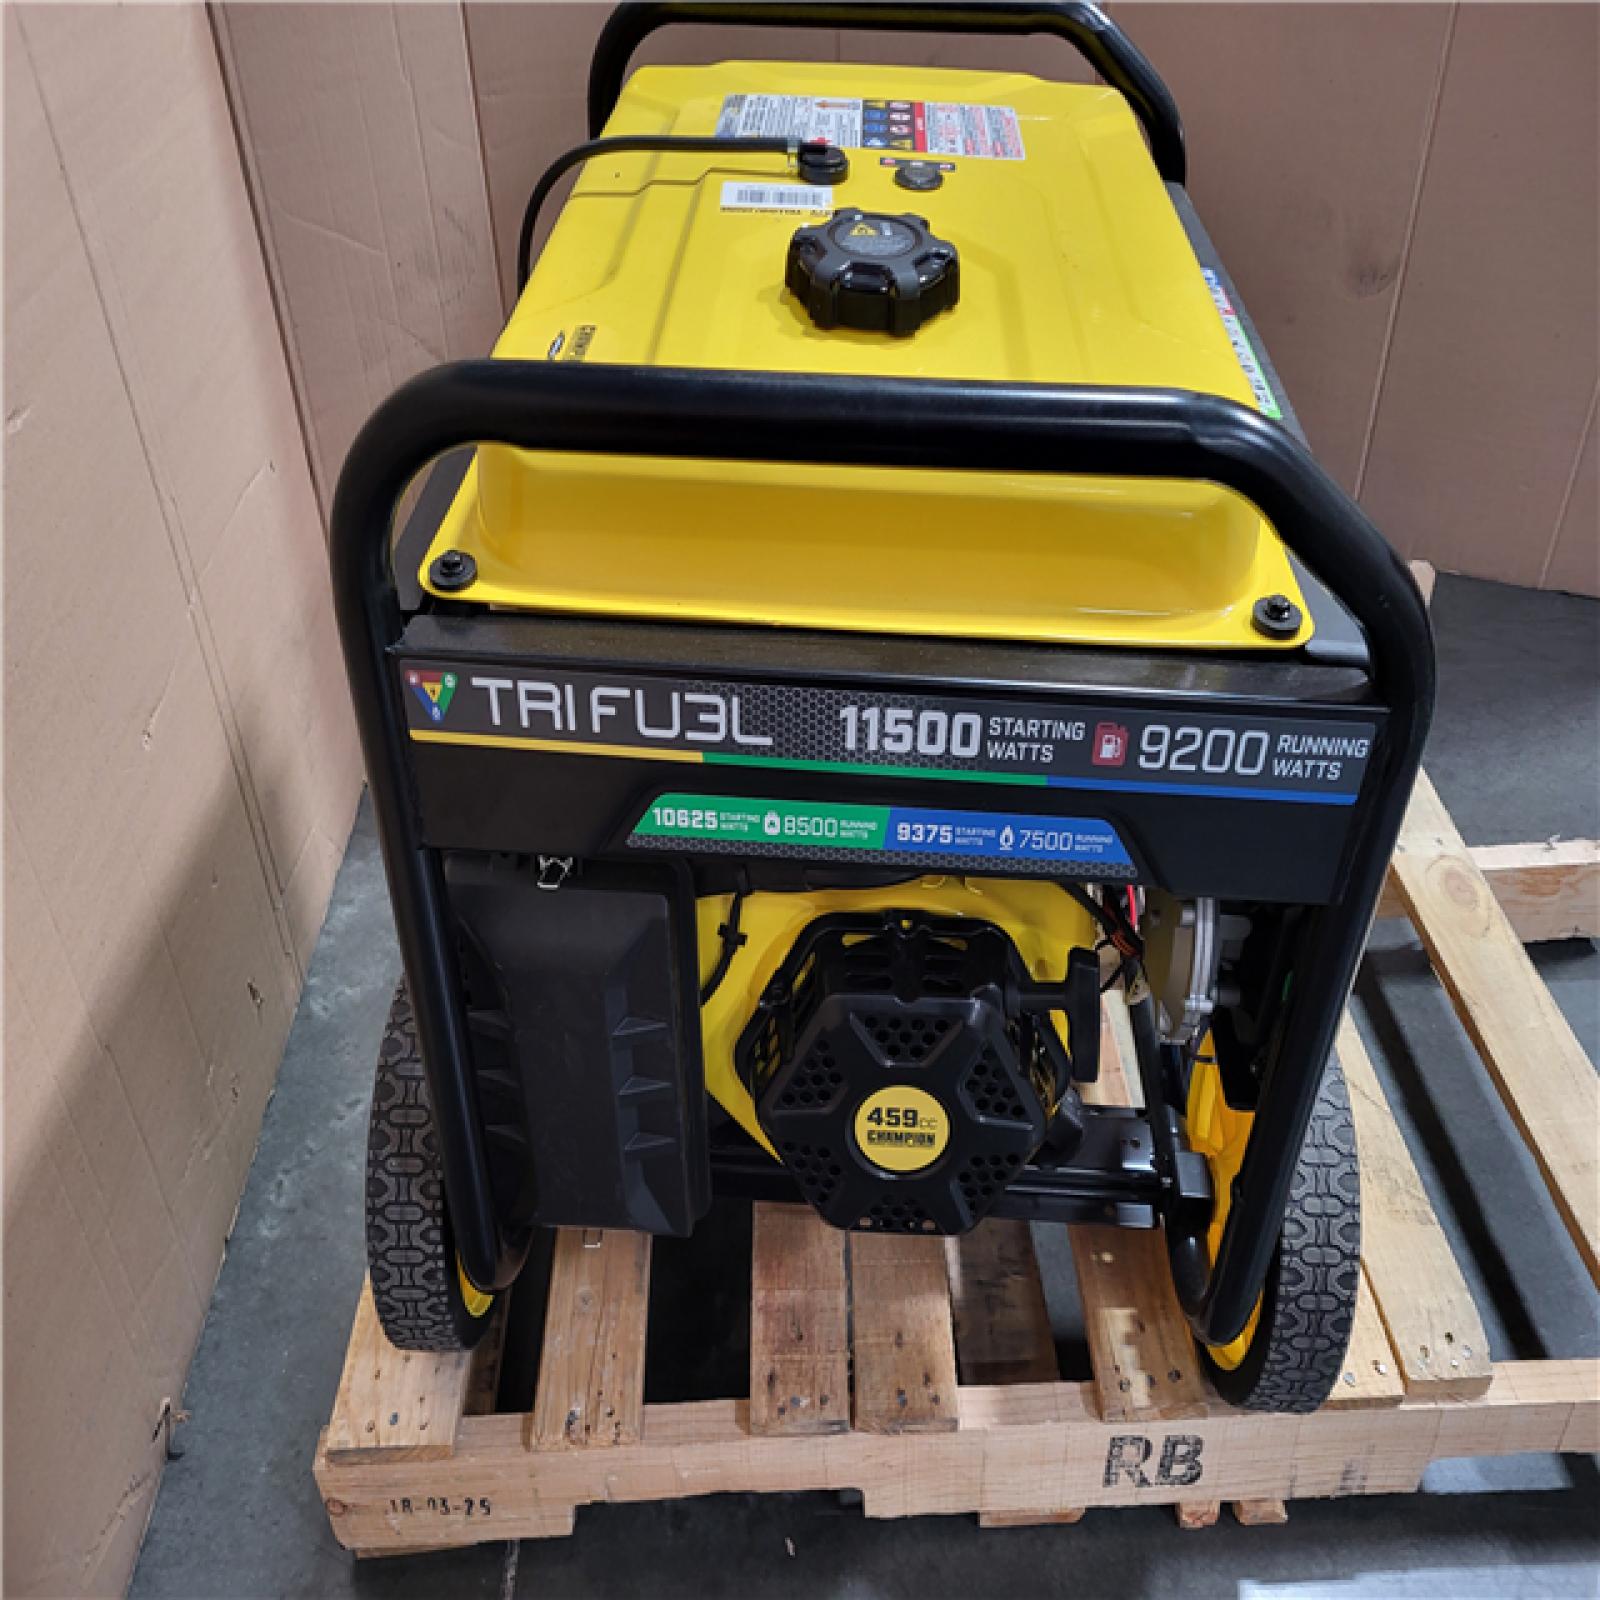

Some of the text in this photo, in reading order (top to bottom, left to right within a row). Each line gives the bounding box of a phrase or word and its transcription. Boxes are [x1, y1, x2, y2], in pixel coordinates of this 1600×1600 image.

[471, 676, 576, 732] TRI
[840, 705, 982, 758] 11500
[988, 716, 1086, 742] STARTING
[987, 741, 1054, 765] WATTS
[1138, 723, 1270, 776] 9200
[1276, 734, 1370, 759] RUNNING
[1271, 758, 1342, 782] WATTS
[784, 815, 837, 838] 8500
[897, 822, 953, 844] 9375
[1018, 829, 1073, 851] 7500
[867, 1129, 936, 1148] CHAMPION
[1103, 1434, 1204, 1488] RB
